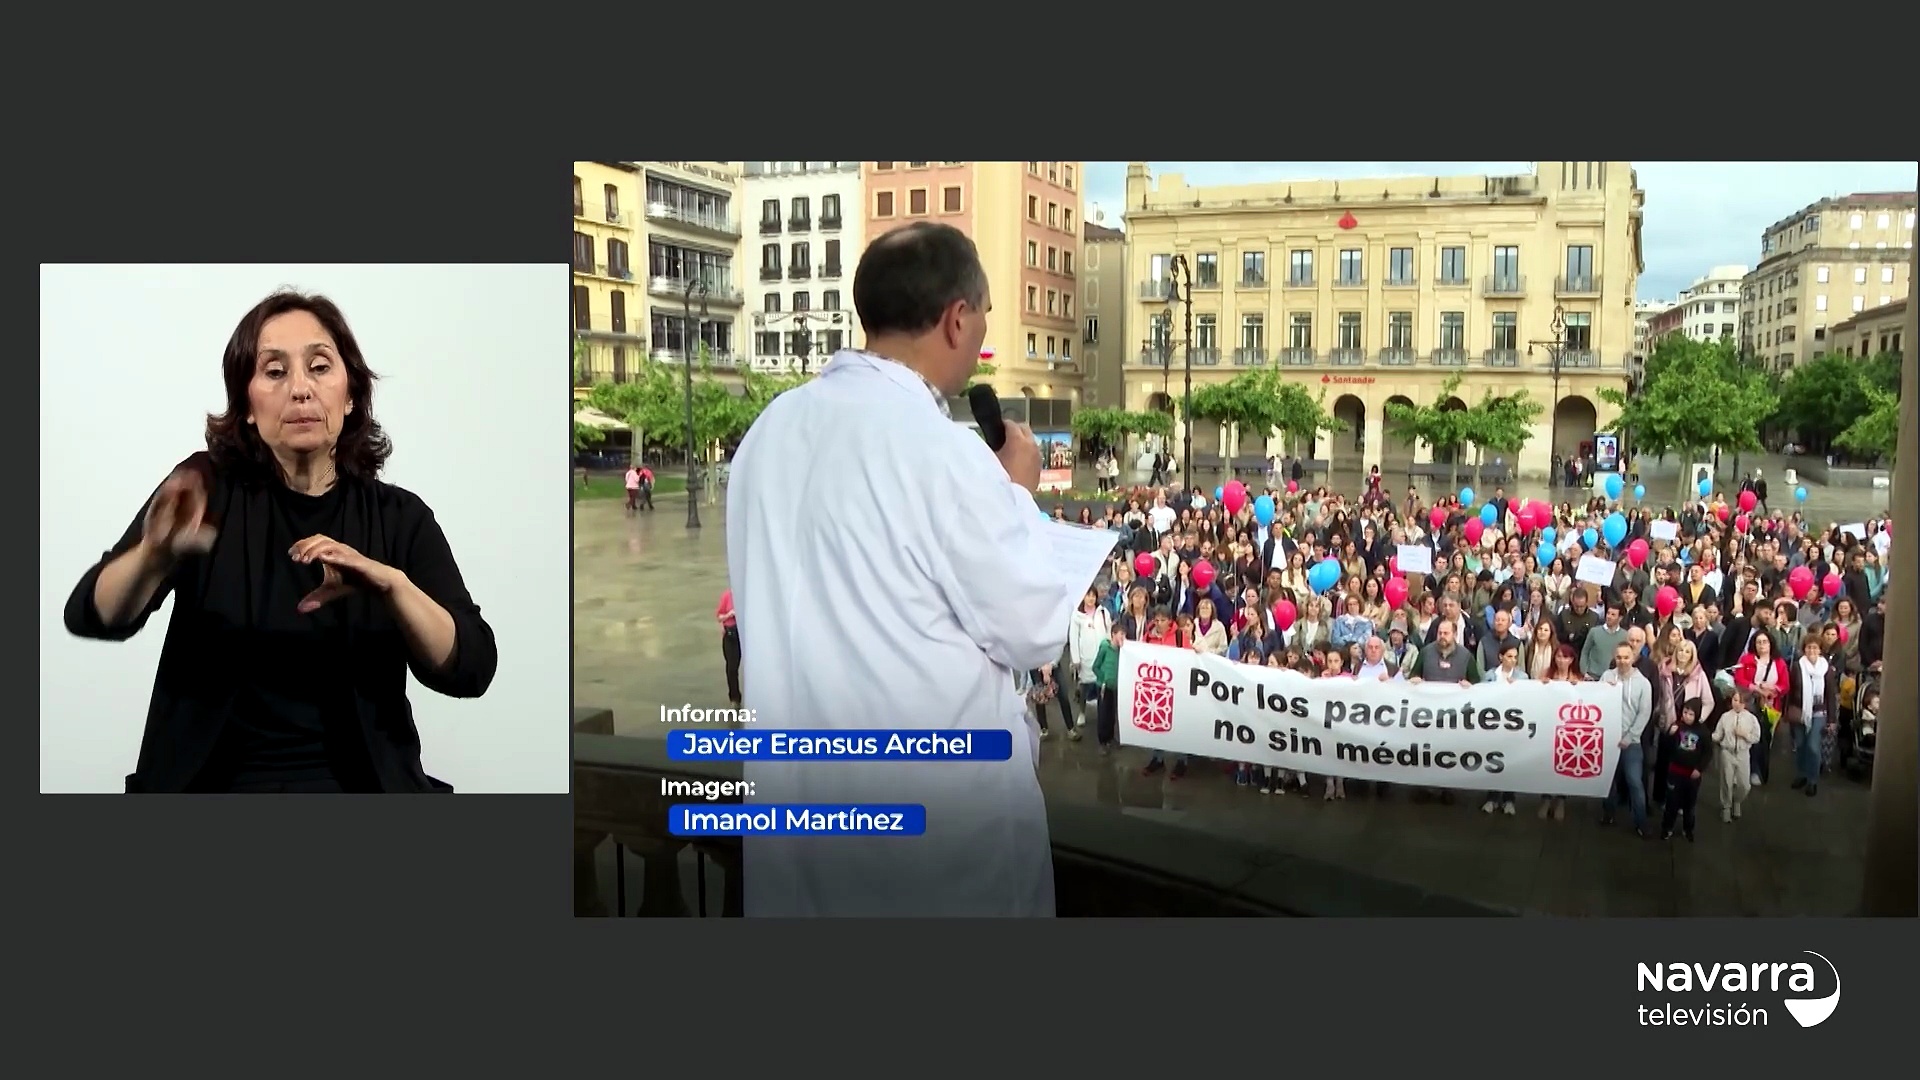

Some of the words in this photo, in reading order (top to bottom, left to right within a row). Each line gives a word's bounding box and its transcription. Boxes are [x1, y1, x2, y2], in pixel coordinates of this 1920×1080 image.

[1333, 375, 1376, 384] Santander
[1189, 668, 1245, 705] Por
[1256, 683, 1309, 718] los
[1324, 700, 1537, 739] pacientes,
[1214, 719, 1256, 744] no
[1269, 727, 1323, 756] sin
[1337, 741, 1505, 774] médicos
